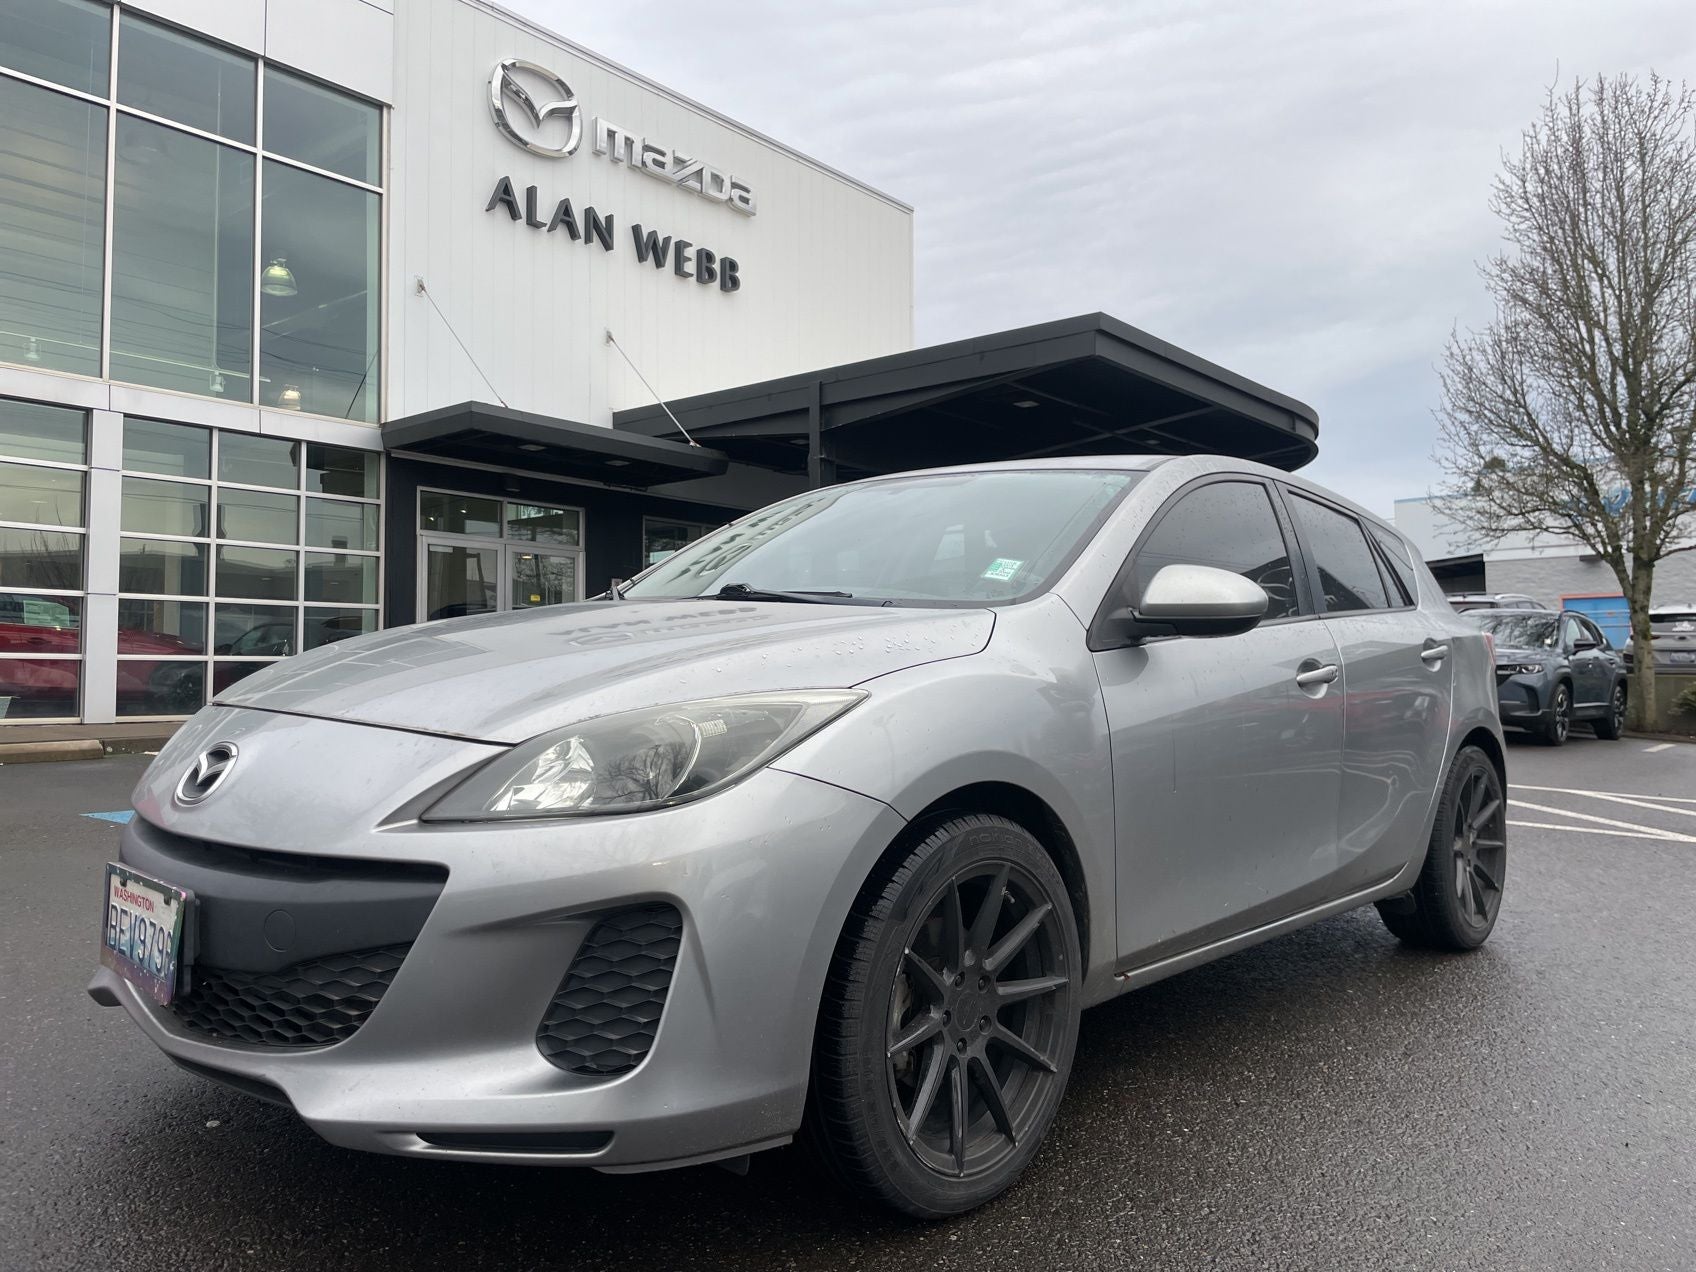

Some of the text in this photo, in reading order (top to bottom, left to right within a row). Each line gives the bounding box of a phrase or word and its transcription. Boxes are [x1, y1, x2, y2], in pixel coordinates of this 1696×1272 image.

[592, 116, 757, 218] mazda
[485, 175, 741, 293] ALAN WEBB
[113, 885, 155, 913] WASHINGTON
